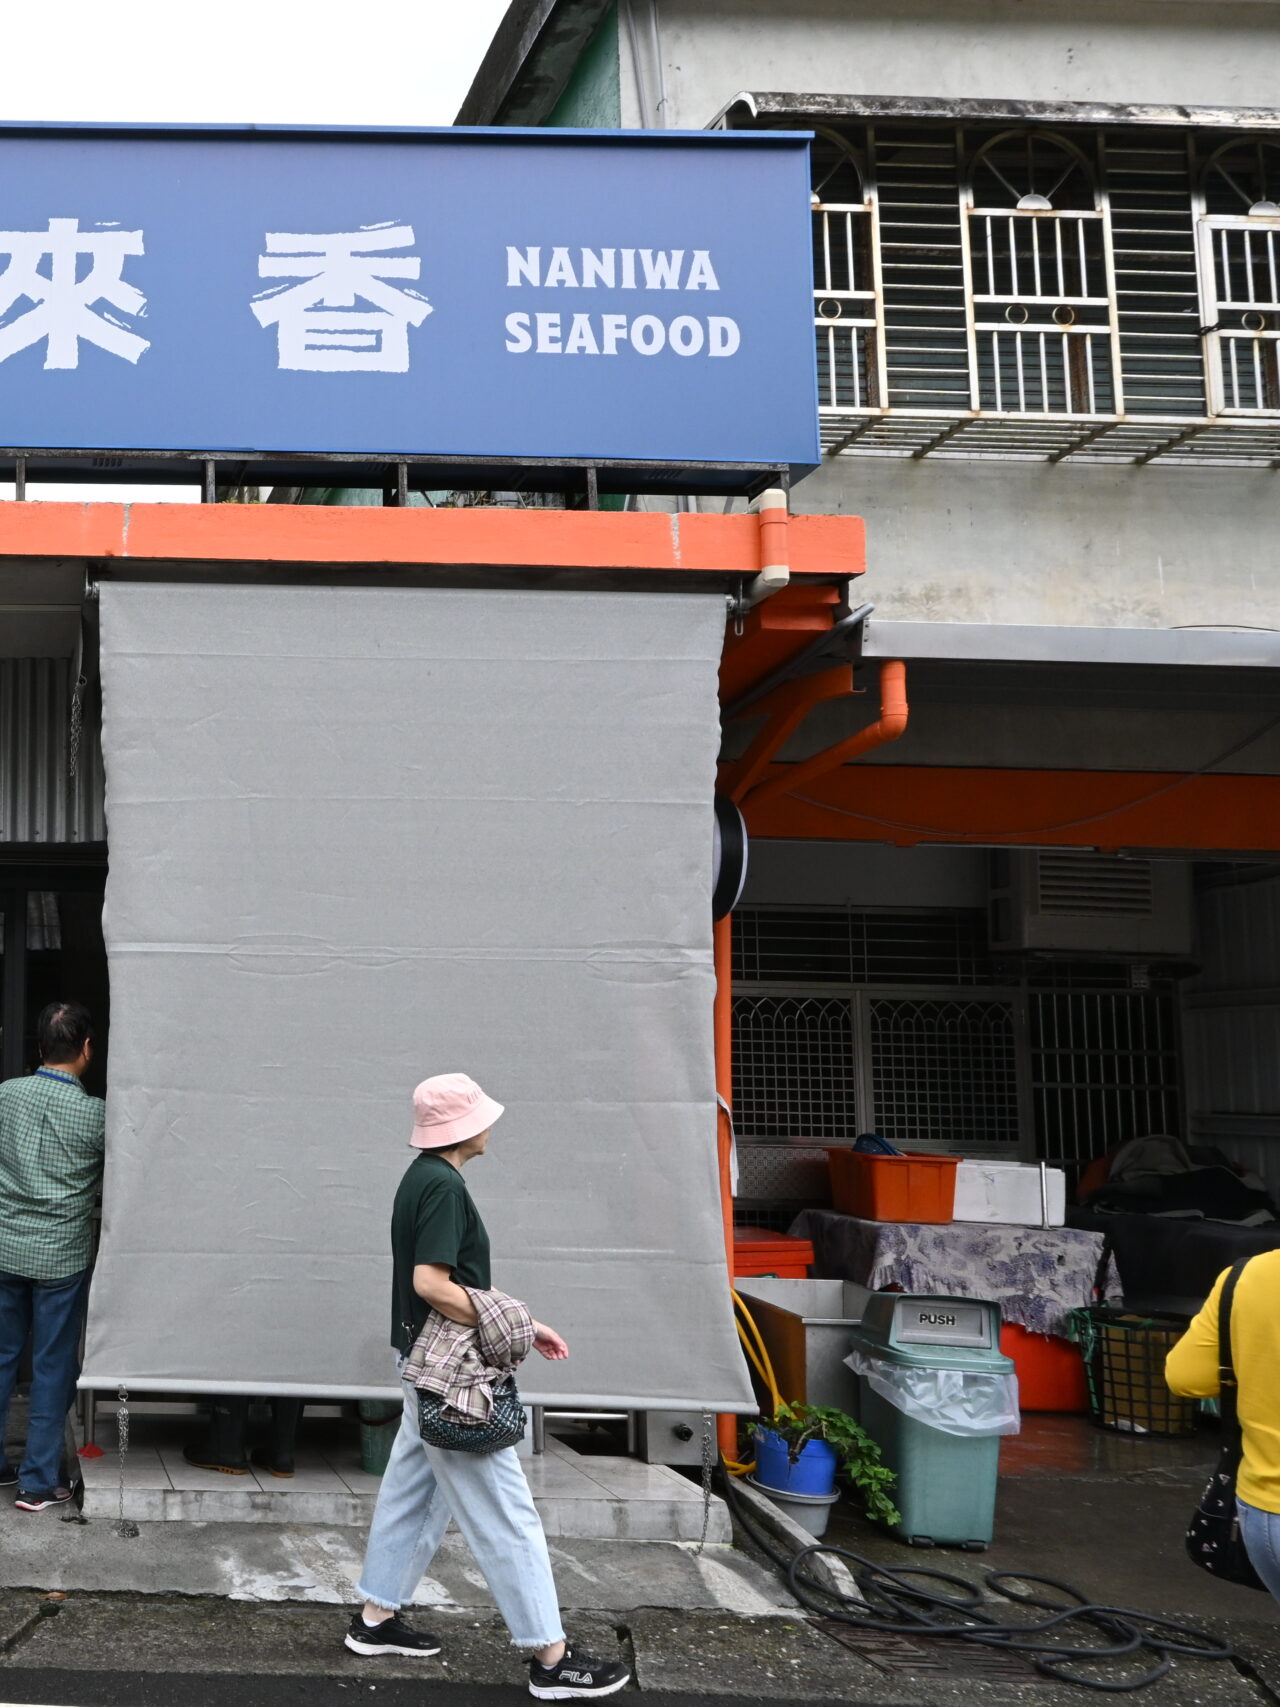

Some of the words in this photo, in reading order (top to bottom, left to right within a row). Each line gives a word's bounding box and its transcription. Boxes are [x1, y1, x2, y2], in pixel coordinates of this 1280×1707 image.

[505, 246, 720, 291] NANIWA
[504, 312, 741, 357] SEAFOOD
[919, 1313, 956, 1326] PUSH
[558, 1670, 594, 1685] FILA
